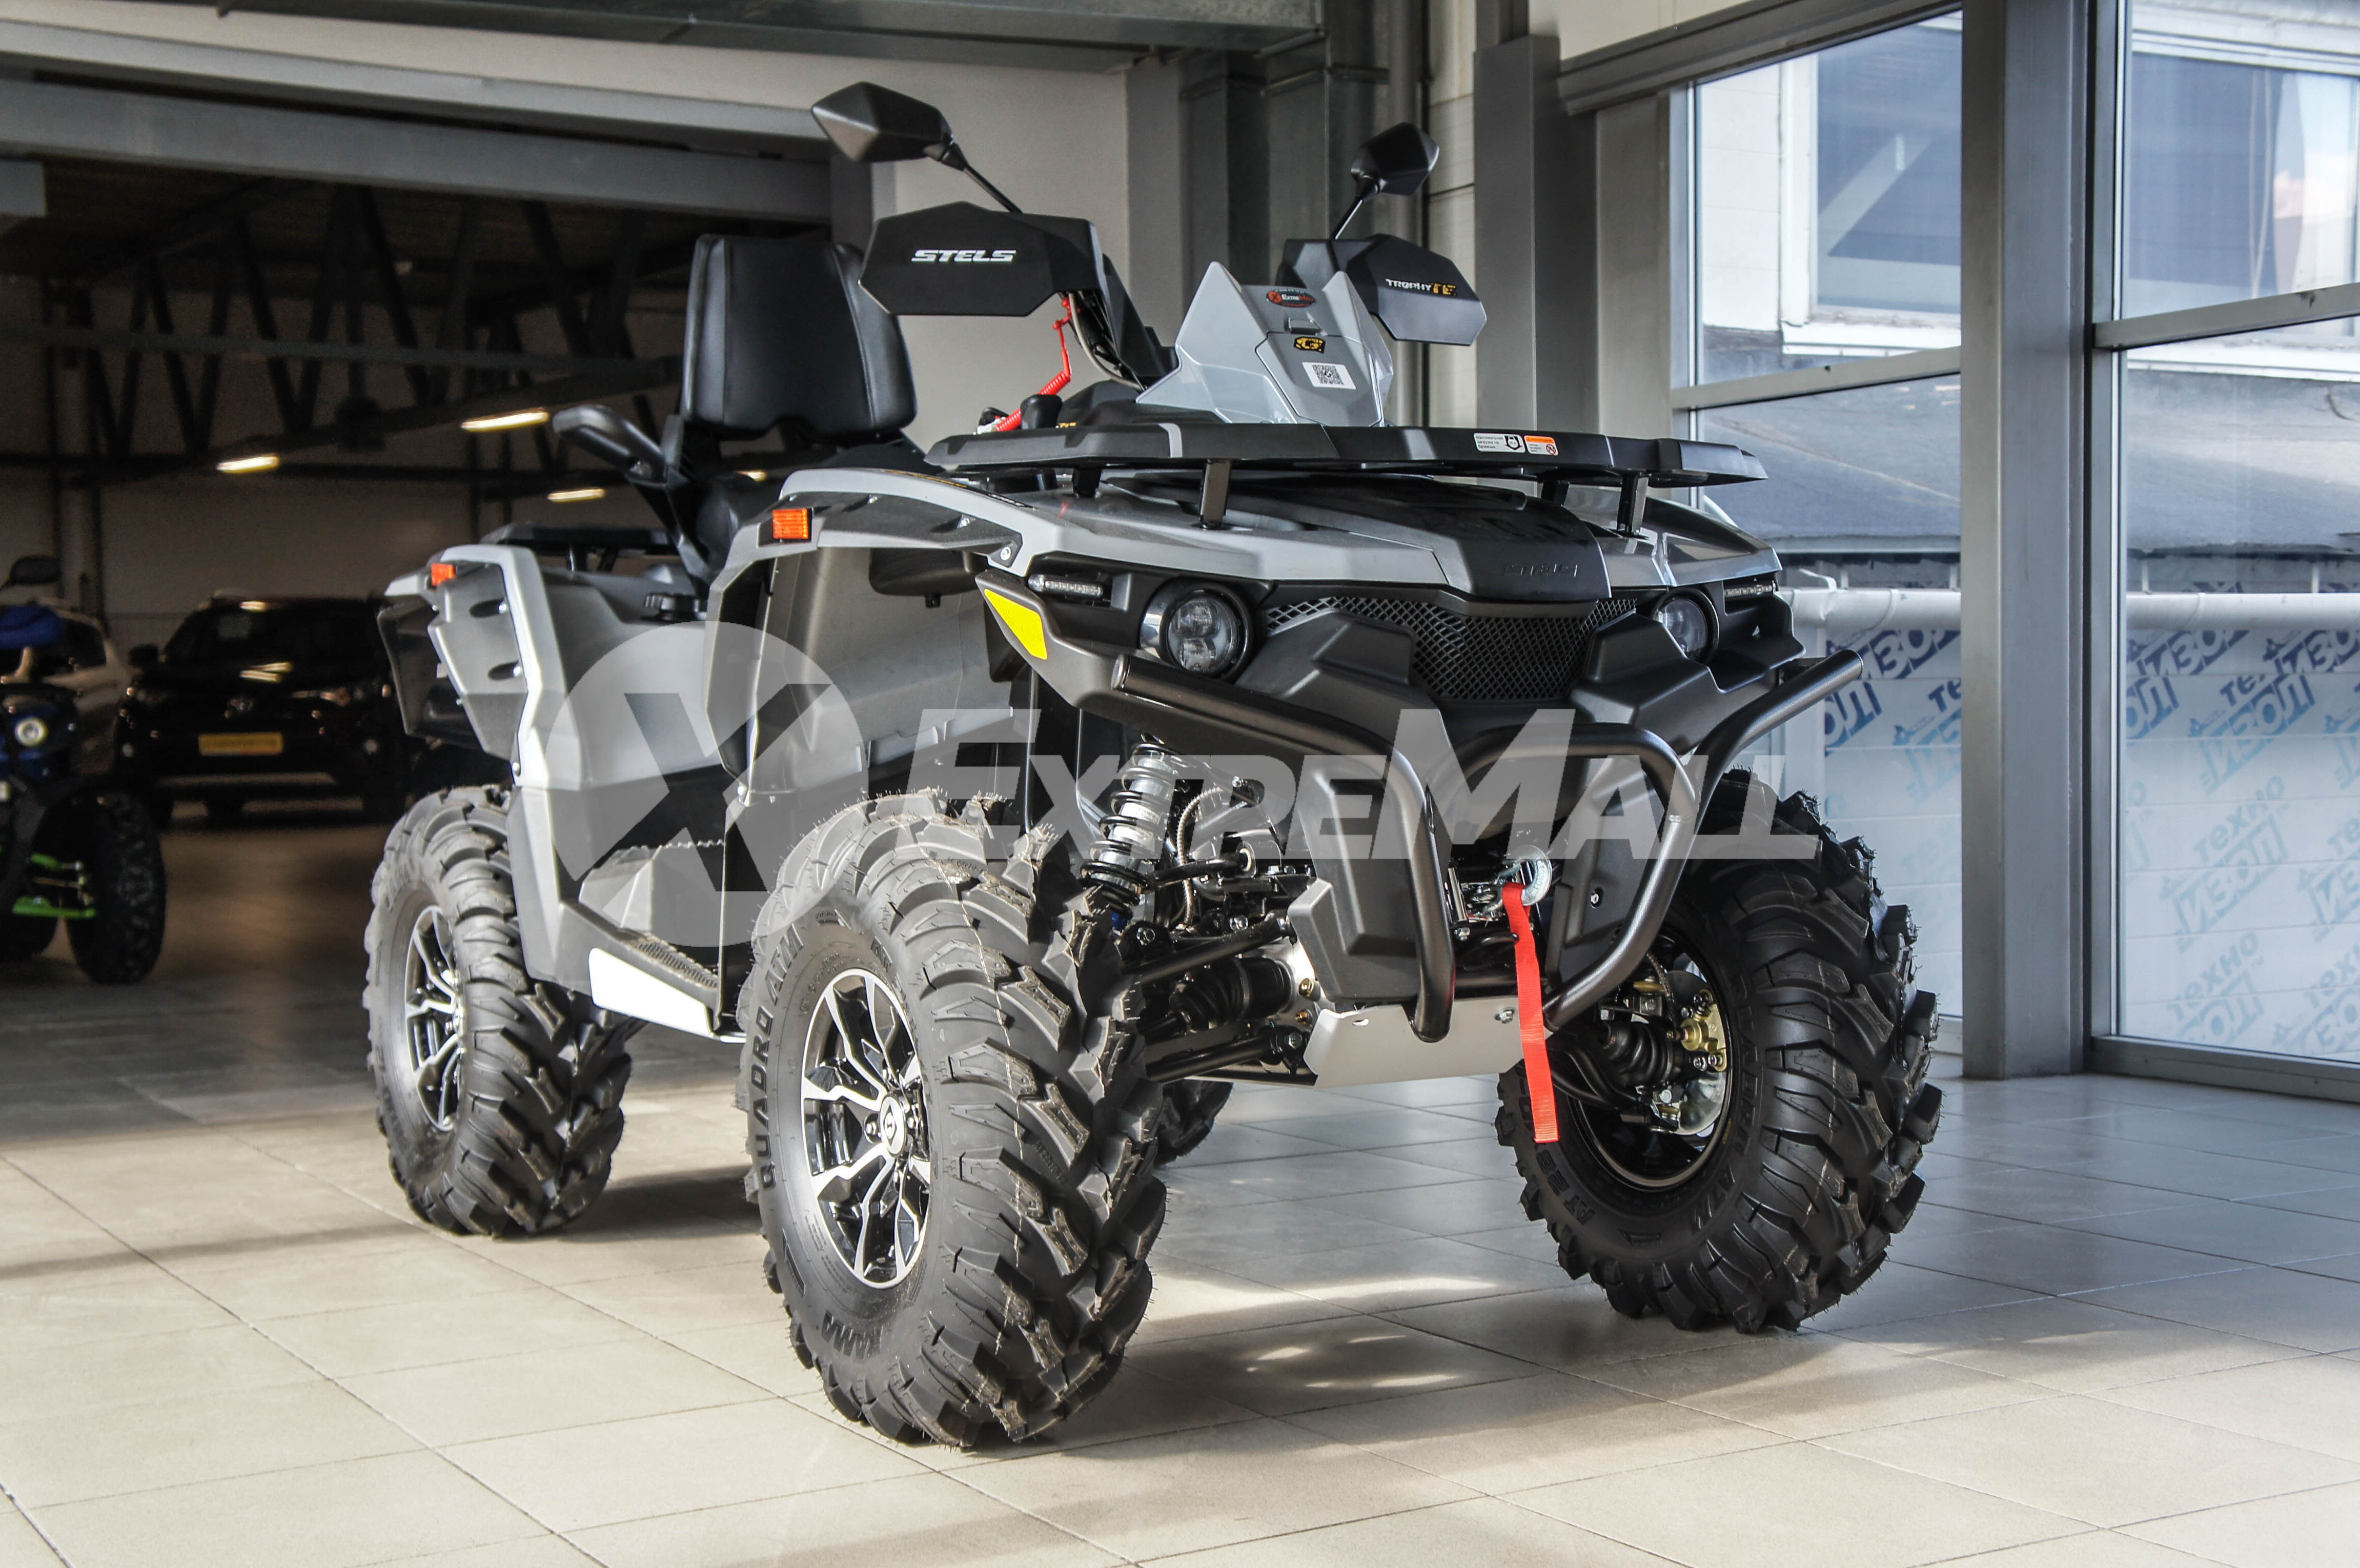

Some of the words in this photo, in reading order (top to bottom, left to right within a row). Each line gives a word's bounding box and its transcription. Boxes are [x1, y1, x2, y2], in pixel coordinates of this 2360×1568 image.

[911, 249, 1016, 262] STELS
[1385, 278, 1432, 291] TROPHY
[749, 1009, 777, 1191] QUADRO
